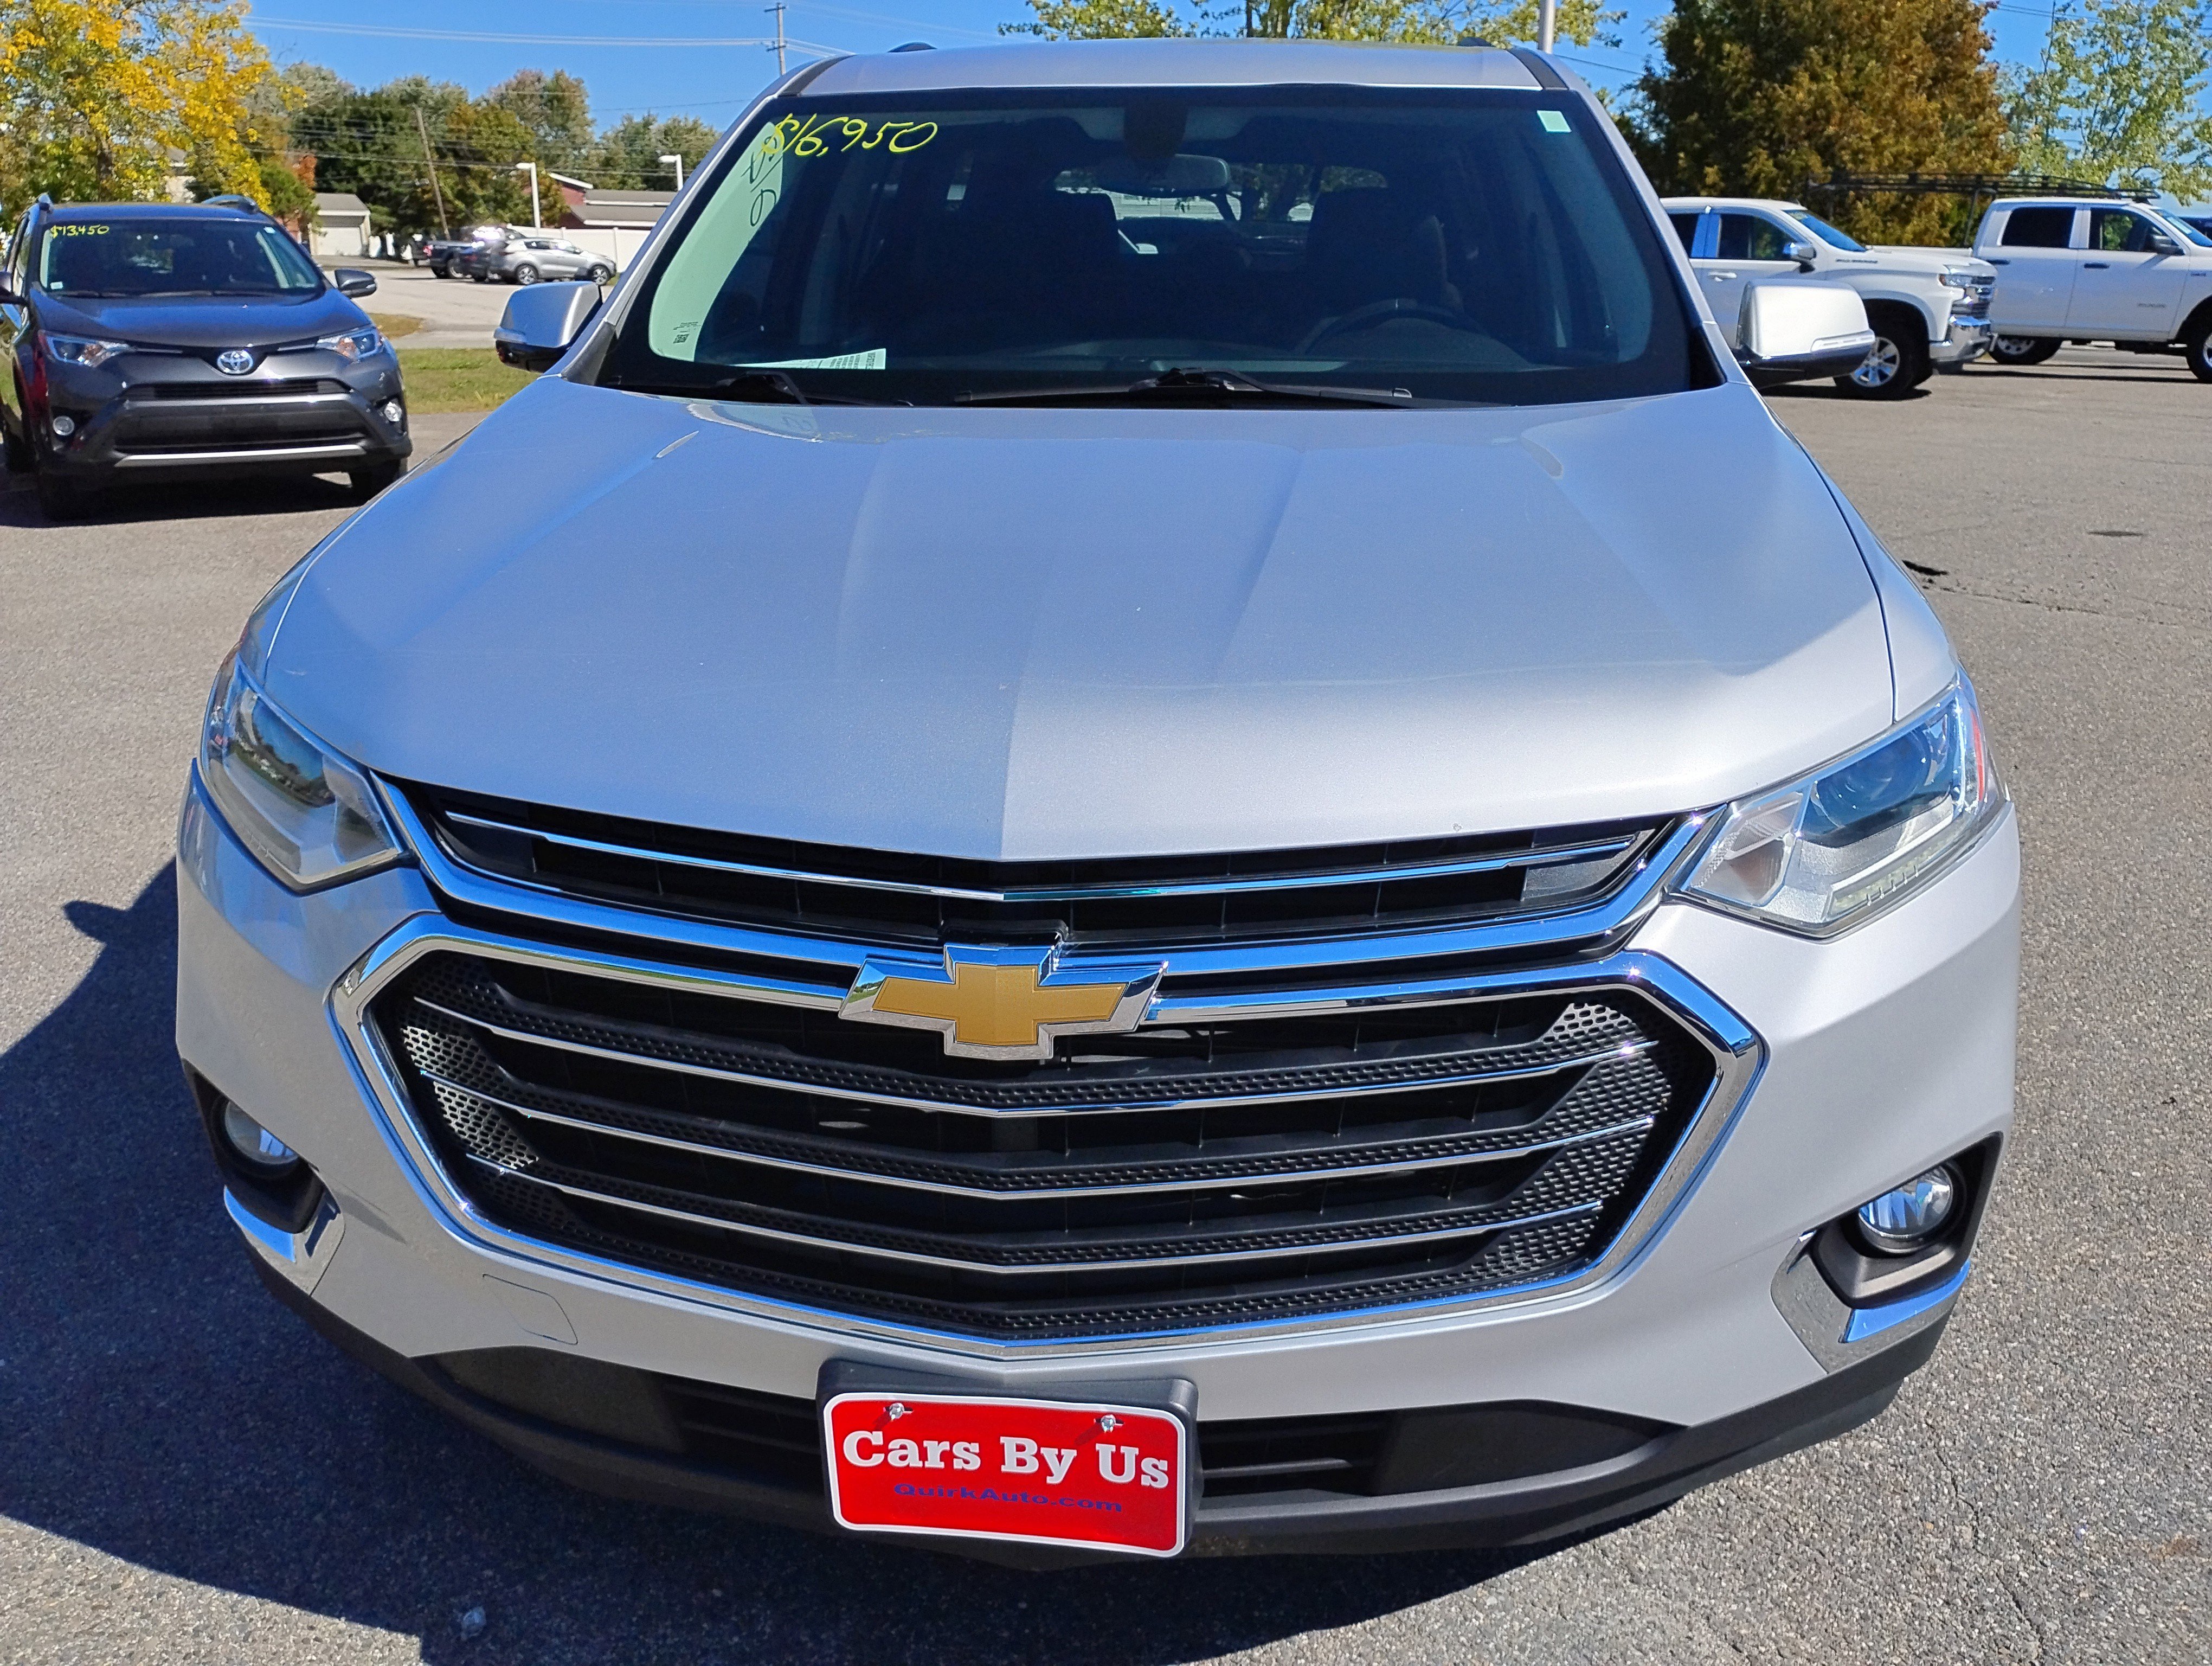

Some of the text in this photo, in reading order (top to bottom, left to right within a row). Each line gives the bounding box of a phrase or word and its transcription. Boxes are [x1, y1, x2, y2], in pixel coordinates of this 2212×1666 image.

[758, 113, 938, 157] $16,950
[843, 1430, 1169, 1489] Cars By Us
[893, 1483, 1123, 1513] QuirkAuto.com
